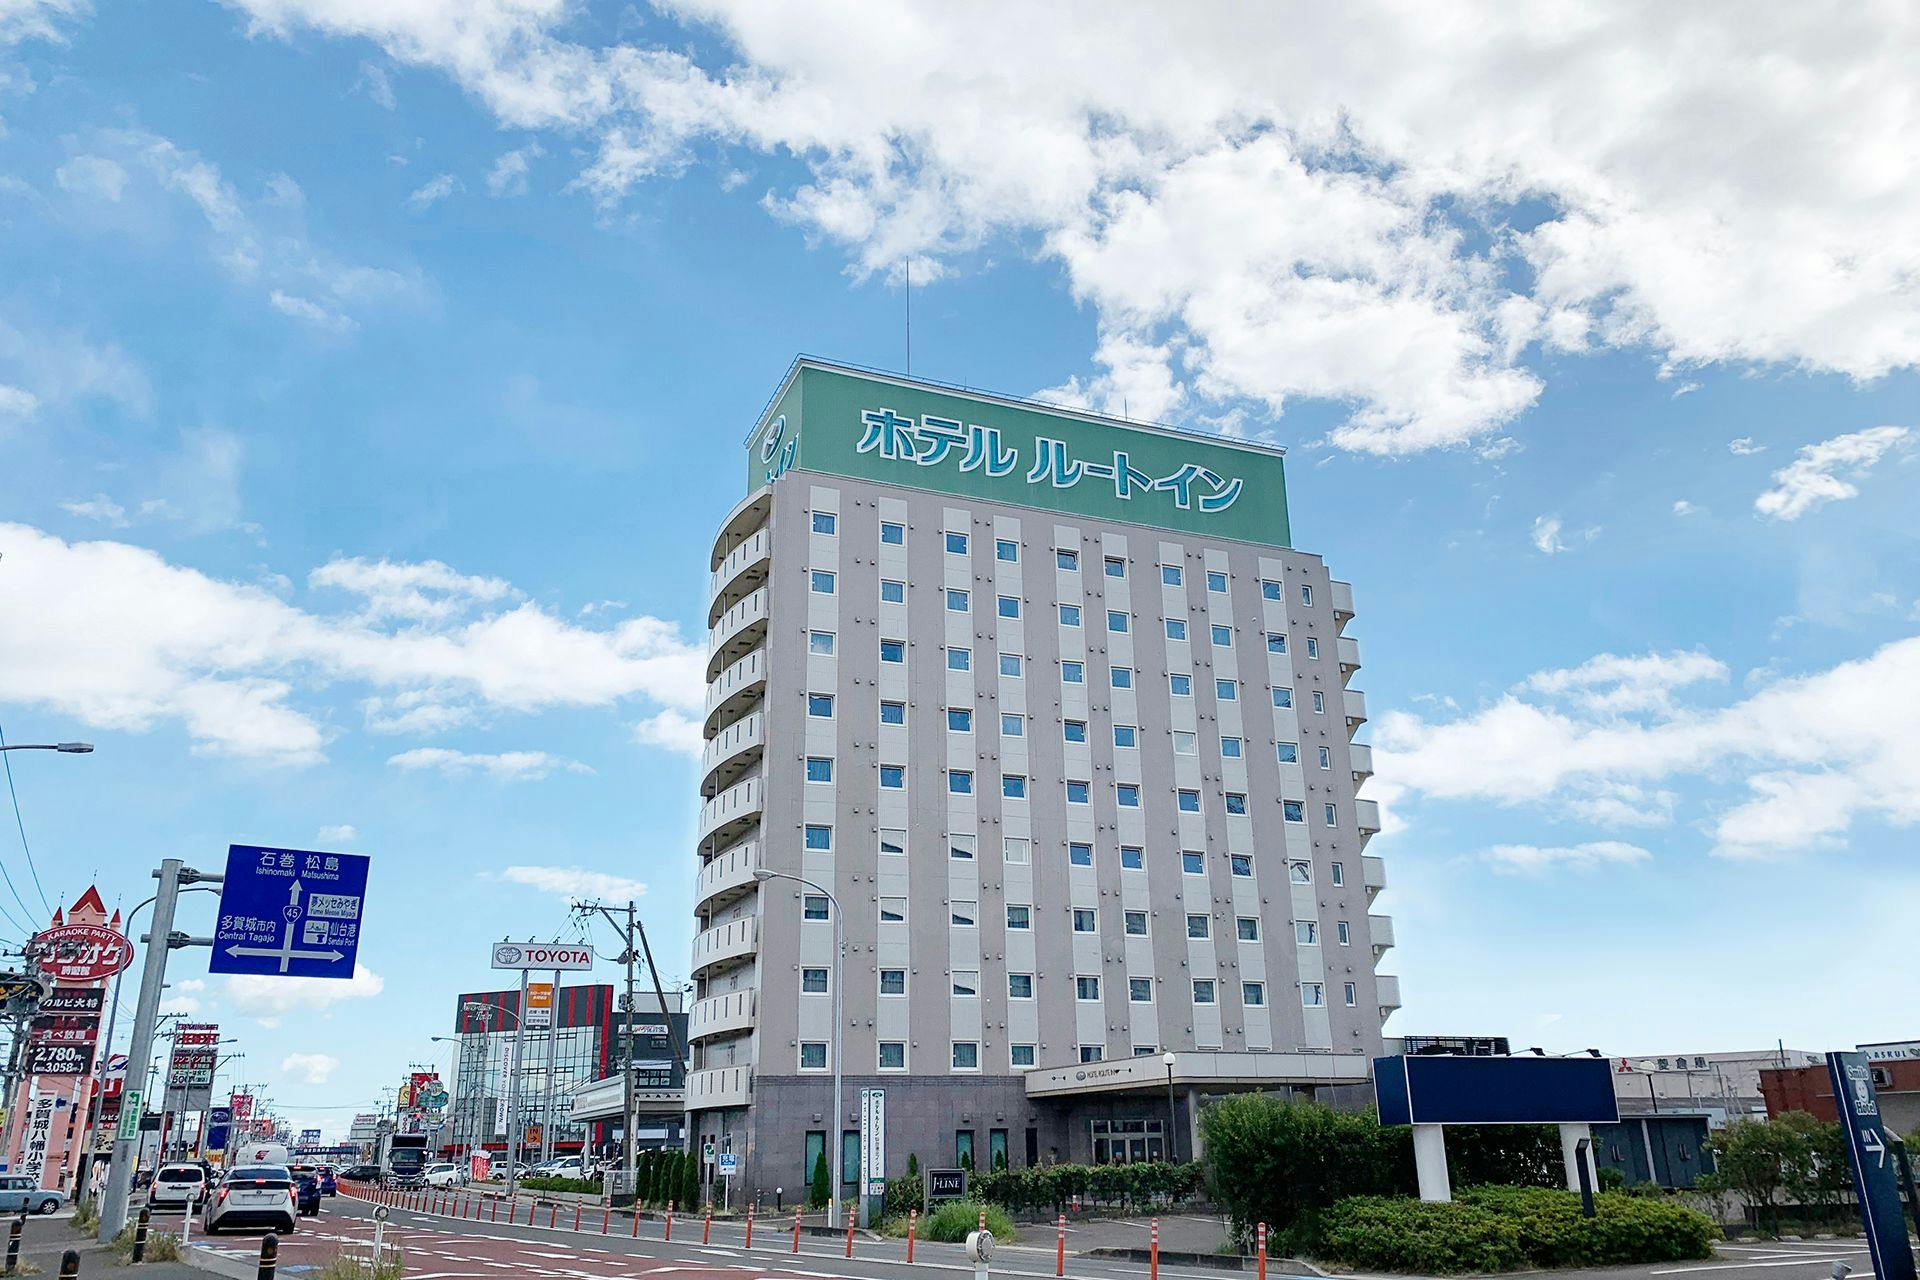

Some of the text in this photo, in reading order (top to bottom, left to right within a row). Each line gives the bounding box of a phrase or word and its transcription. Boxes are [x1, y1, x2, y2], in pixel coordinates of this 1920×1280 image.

[856, 407, 1019, 477] ホテル
[1026, 436, 1244, 513] ルートイン
[260, 851, 340, 872] 石巻 松島
[255, 866, 340, 881] Ishinomaki Matsushima
[286, 908, 298, 918] 45
[220, 915, 277, 932] 多賀城市内
[330, 922, 357, 937] 仙台港
[47, 928, 118, 942] KARAOKE PARTY
[218, 931, 275, 943] Central Tagajo
[525, 949, 590, 964] TOYOTA
[1874, 1050, 1907, 1060] ASKUL
[502, 1047, 510, 1080] DISCOVER
[1641, 1057, 1708, 1071] 菱倉庫
[1847, 1065, 1869, 1080] Smile
[1855, 1101, 1877, 1115] Hotel
[1861, 1129, 1872, 1143] IN
